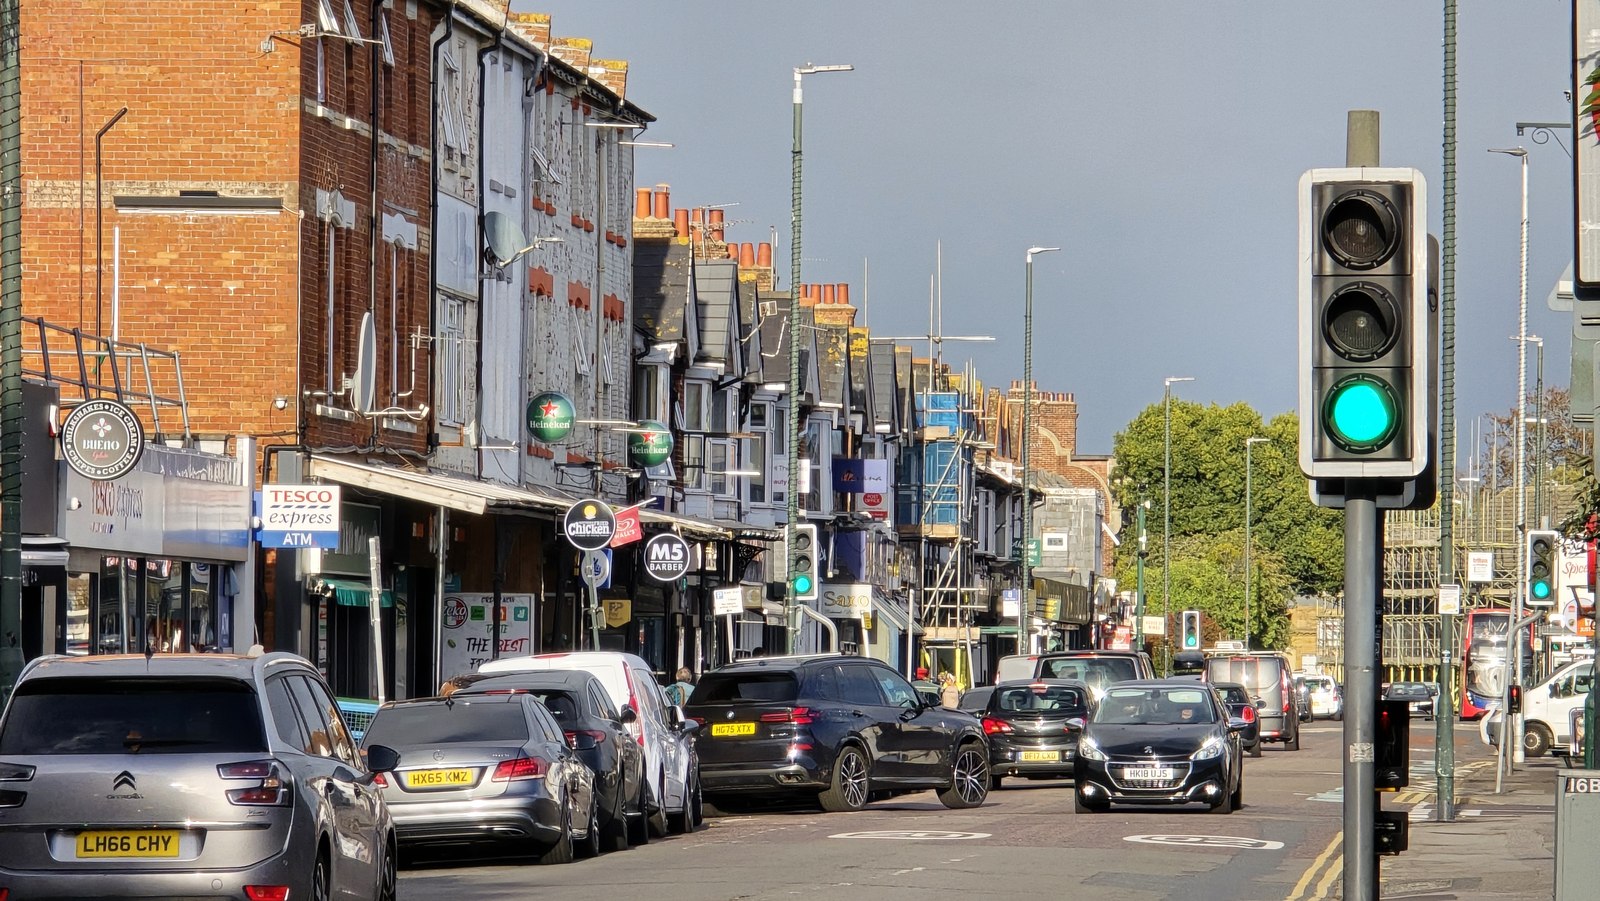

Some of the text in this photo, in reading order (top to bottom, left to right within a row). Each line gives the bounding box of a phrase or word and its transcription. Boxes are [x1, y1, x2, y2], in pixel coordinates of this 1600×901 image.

[66, 403, 104, 443] MILKSHAKES
[110, 405, 138, 446] ICE CREAM
[530, 420, 570, 428] Heineken
[631, 446, 668, 454] Heineken
[69, 450, 96, 474] CREPES
[102, 452, 132, 474] COFFEE
[92, 480, 115, 516] TESCO
[270, 490, 332, 503] TESCO
[269, 512, 332, 528] express
[568, 522, 610, 536] Chicken
[282, 533, 312, 546] ATM
[651, 544, 683, 560] M5
[824, 591, 869, 607] Saxo
[466, 638, 491, 654] THE
[716, 725, 734, 734] HG75
[413, 772, 468, 784] HX65 KMZ
[84, 836, 172, 852] LH66 CHY
